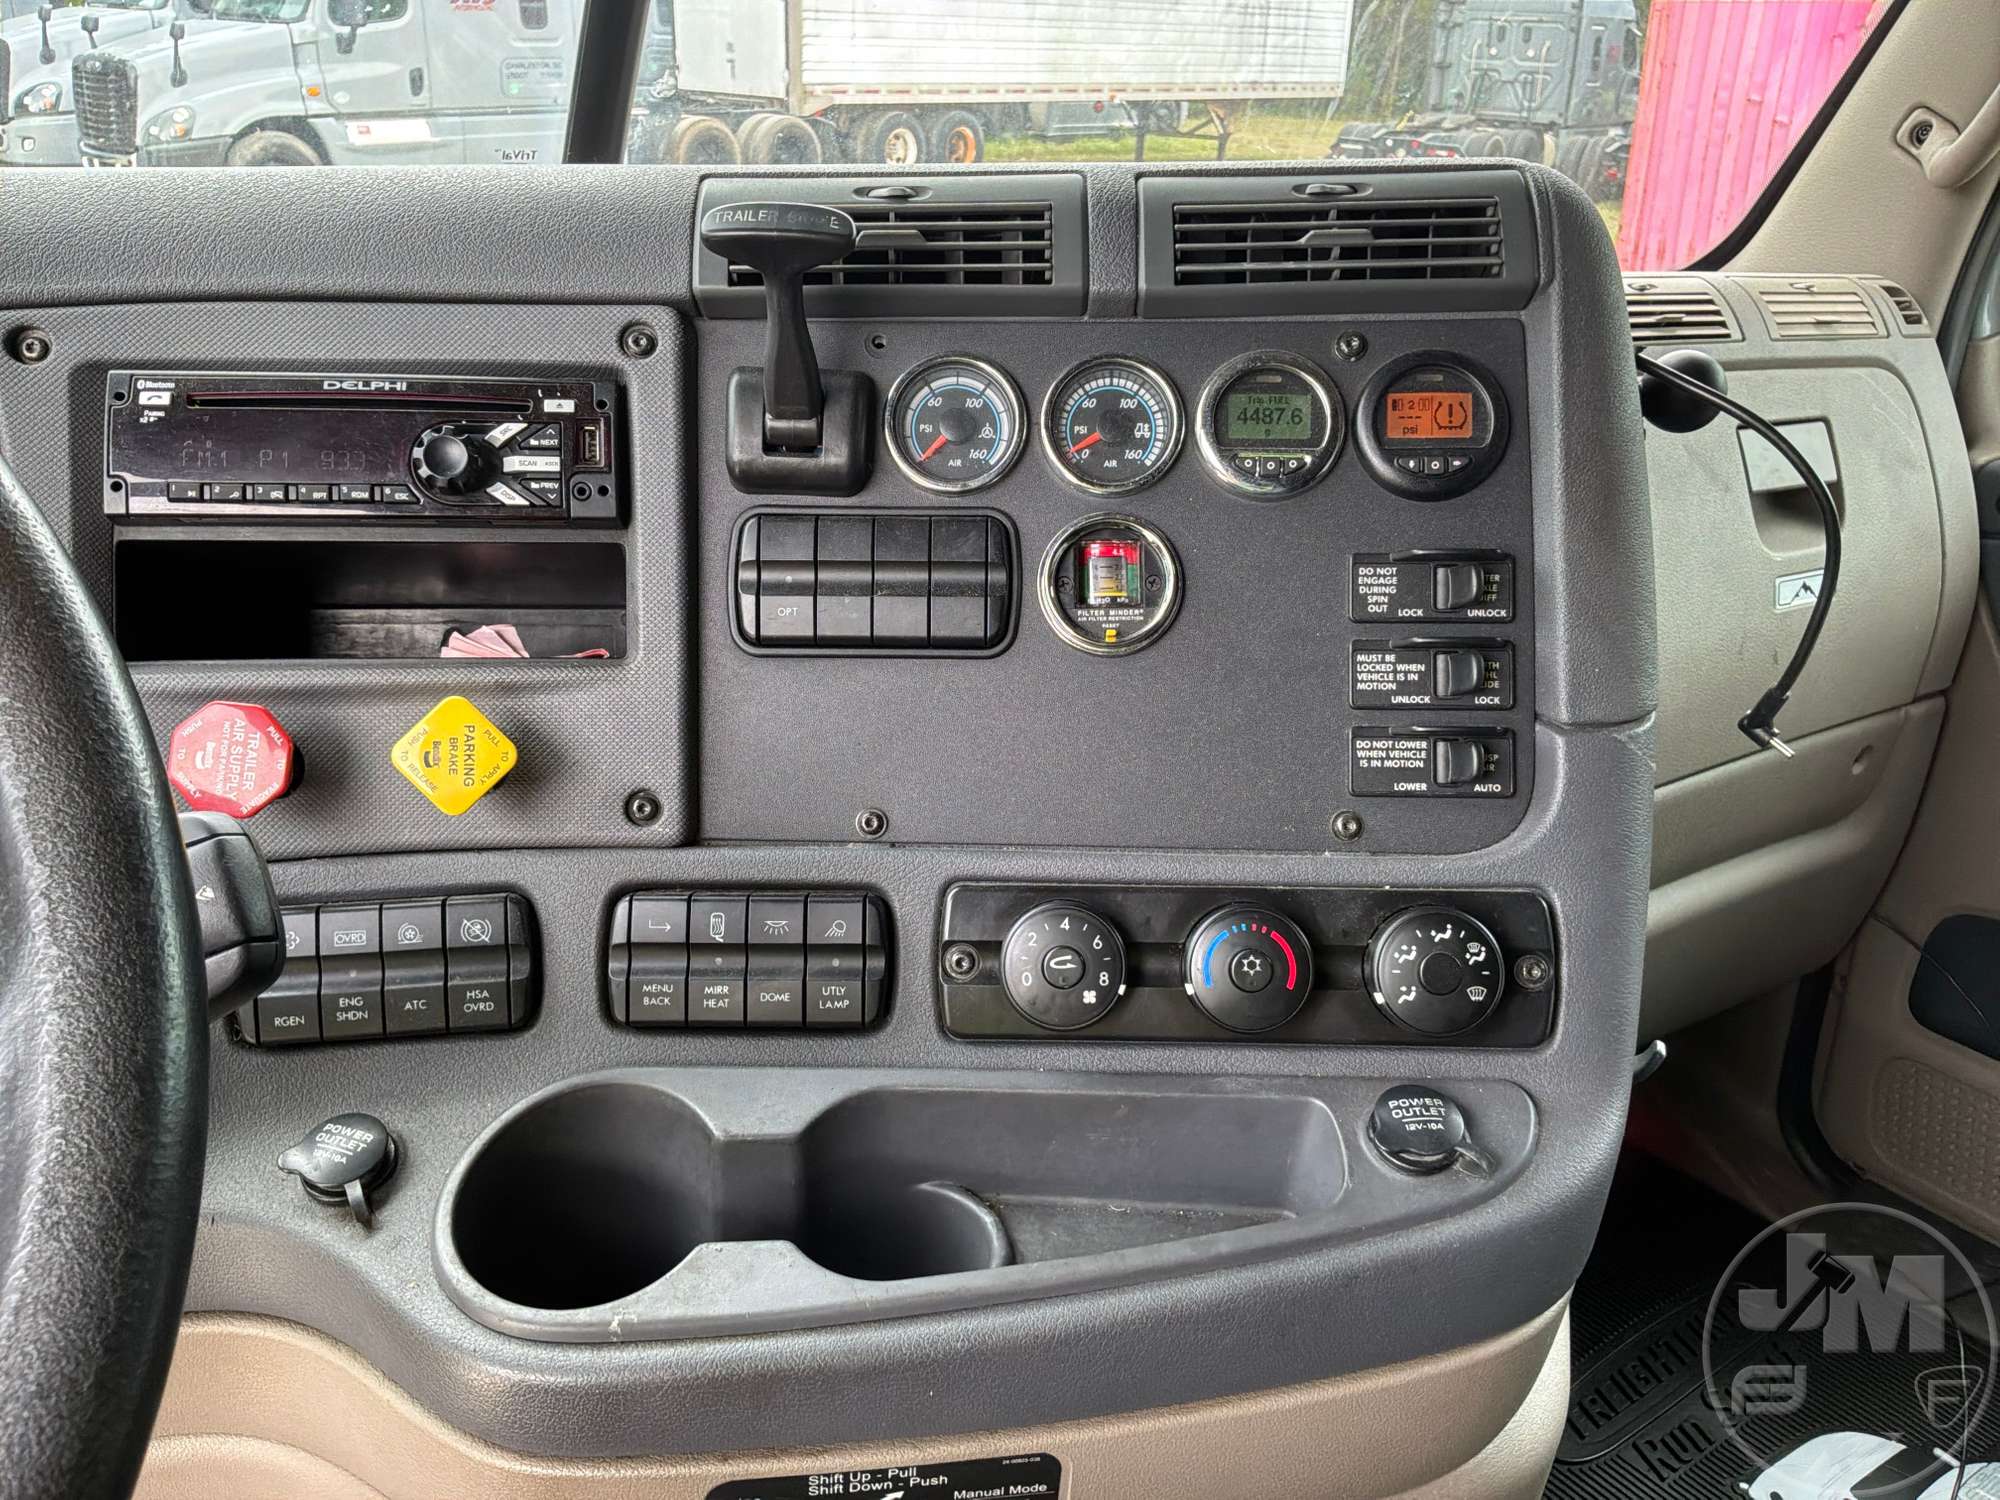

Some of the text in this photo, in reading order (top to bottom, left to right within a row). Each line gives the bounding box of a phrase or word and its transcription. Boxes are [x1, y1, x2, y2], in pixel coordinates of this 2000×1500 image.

[714, 210, 780, 224] TRAILER
[323, 380, 407, 391] DELPHI
[927, 397, 943, 407] 60
[965, 398, 984, 409] 100
[1081, 397, 1097, 408] 60
[1119, 398, 1138, 409] 100
[1407, 399, 1416, 410] 2
[1236, 407, 1304, 425] 4487.6
[919, 424, 933, 433] PSI
[1074, 425, 1088, 435] PSI
[1402, 424, 1418, 436] psi
[969, 448, 988, 459] 160
[1081, 450, 1090, 460] 0
[1124, 449, 1143, 460] 160
[948, 458, 962, 467] AIR
[1103, 459, 1118, 468] AIR
[312, 491, 328, 499] RPT
[394, 492, 409, 500] ESC
[1358, 567, 1397, 576] DO NOT
[1358, 577, 1398, 585] ENGAGE
[1359, 586, 1397, 594] DURING
[1367, 595, 1388, 603] SPIN
[777, 607, 799, 617] OPT
[1367, 605, 1388, 613] OUT
[1398, 608, 1424, 617] LOCK
[1467, 609, 1507, 617] UNLOCK
[1356, 654, 1396, 662] MUST BE
[1357, 663, 1425, 672] LOCKED WHEN
[1357, 673, 1418, 681] VEHICLE IS IN
[1356, 682, 1397, 690] MOTION
[1391, 695, 1431, 704] UNLOCK
[1474, 696, 1500, 704] LOCK
[182, 719, 203, 737] PUSH
[221, 720, 231, 738] NOT
[266, 725, 284, 746] PULL
[1356, 740, 1428, 749] DO NOT LOWER
[177, 747, 186, 760] TO
[400, 750, 409, 762] TO
[448, 736, 459, 776] BRAKE
[463, 724, 475, 788] PARKING
[479, 729, 509, 786] PULL TO APPLY
[1356, 750, 1427, 758] WHEN VEHICLE
[226, 718, 246, 801] AIR SUPPLY
[242, 731, 261, 791] TRAILER
[1359, 760, 1424, 768] IS IN MOTION
[1393, 782, 1428, 791] LOWER
[1474, 783, 1501, 792] AUTO
[1060, 916, 1070, 931] 4
[336, 932, 366, 944] OVRD
[1028, 932, 1037, 947] 2
[1092, 934, 1103, 950] 6
[1022, 972, 1032, 987] 0
[1099, 971, 1109, 987] 8
[466, 989, 490, 1000] HSA
[642, 984, 674, 994] MENU
[704, 985, 730, 995] MIRR
[822, 986, 847, 996] UTLY
[339, 996, 364, 1008] ENG
[643, 997, 671, 1006] BACK
[760, 992, 791, 1002] DOME
[404, 999, 427, 1011] ATC
[463, 1001, 495, 1013] OVRD
[703, 999, 730, 1009] HEAT
[819, 1000, 850, 1009] LAMP
[274, 1016, 305, 1027] RGEN
[336, 1010, 369, 1022] SHDN
[1388, 1098, 1444, 1110] POWER
[1391, 1107, 1446, 1119] OUTLET
[1404, 1122, 1445, 1131] 12V-10A
[322, 1123, 374, 1143] POWER
[315, 1132, 368, 1152] OUTLET
[808, 1473, 844, 1486] Shift
[849, 1471, 871, 1484] Up
[888, 1467, 918, 1480] Pull
[808, 1484, 844, 1496] Shift
[849, 1480, 893, 1493] Down
[909, 1475, 948, 1488] Push
[953, 1483, 1048, 1500] Manual Mode
